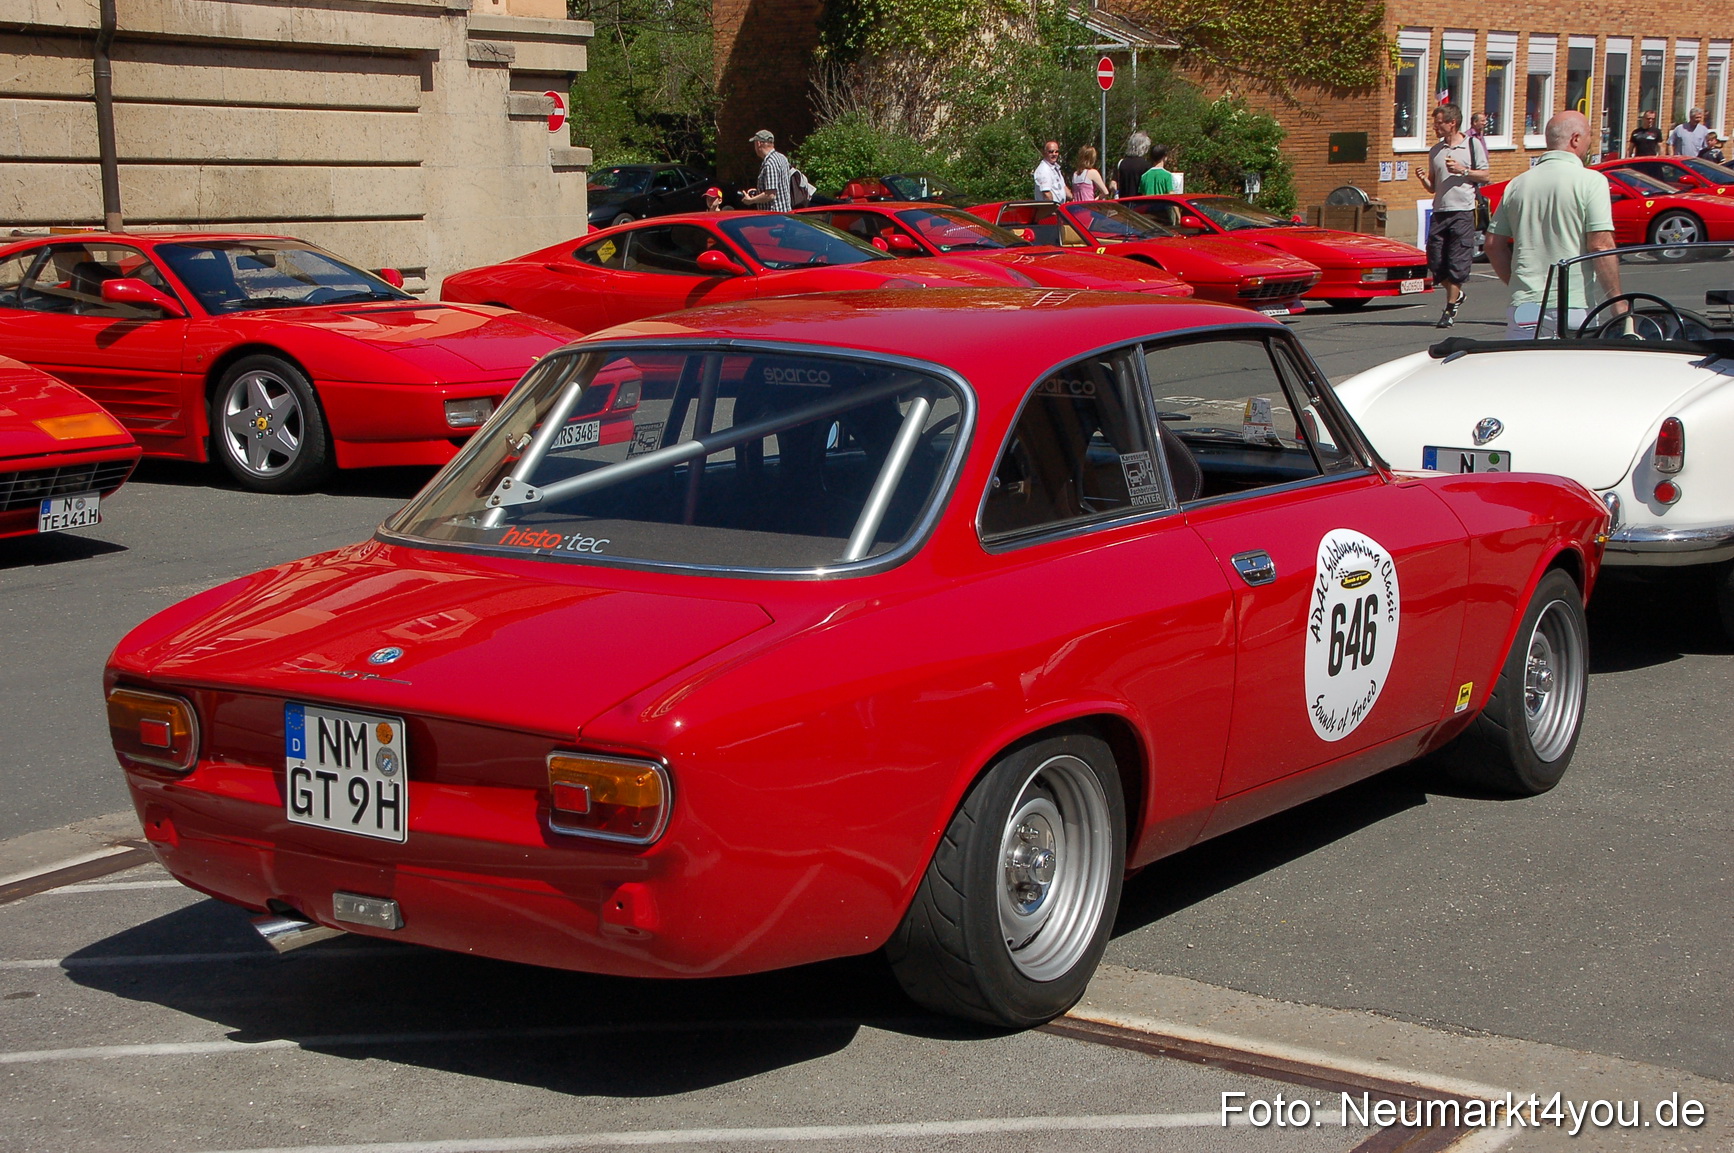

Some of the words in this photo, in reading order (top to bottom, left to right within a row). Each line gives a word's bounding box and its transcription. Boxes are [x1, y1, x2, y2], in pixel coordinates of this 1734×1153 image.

[763, 367, 830, 385] sparco
[560, 426, 573, 445] RS
[575, 423, 593, 442] 348
[1460, 453, 1475, 473] N
[63, 497, 73, 512] N
[1130, 494, 1162, 507] RICHTER
[498, 526, 611, 553] histo:tec
[1310, 573, 1329, 643] ADAC
[1381, 561, 1397, 623] Classic
[1328, 594, 1379, 677] 646
[1311, 694, 1337, 733] Sounds
[1337, 707, 1349, 733] of
[1350, 680, 1377, 726] Speed
[292, 738, 301, 752] D
[318, 716, 369, 772] NM
[291, 767, 339, 820] GT
[348, 776, 400, 831] 9H
